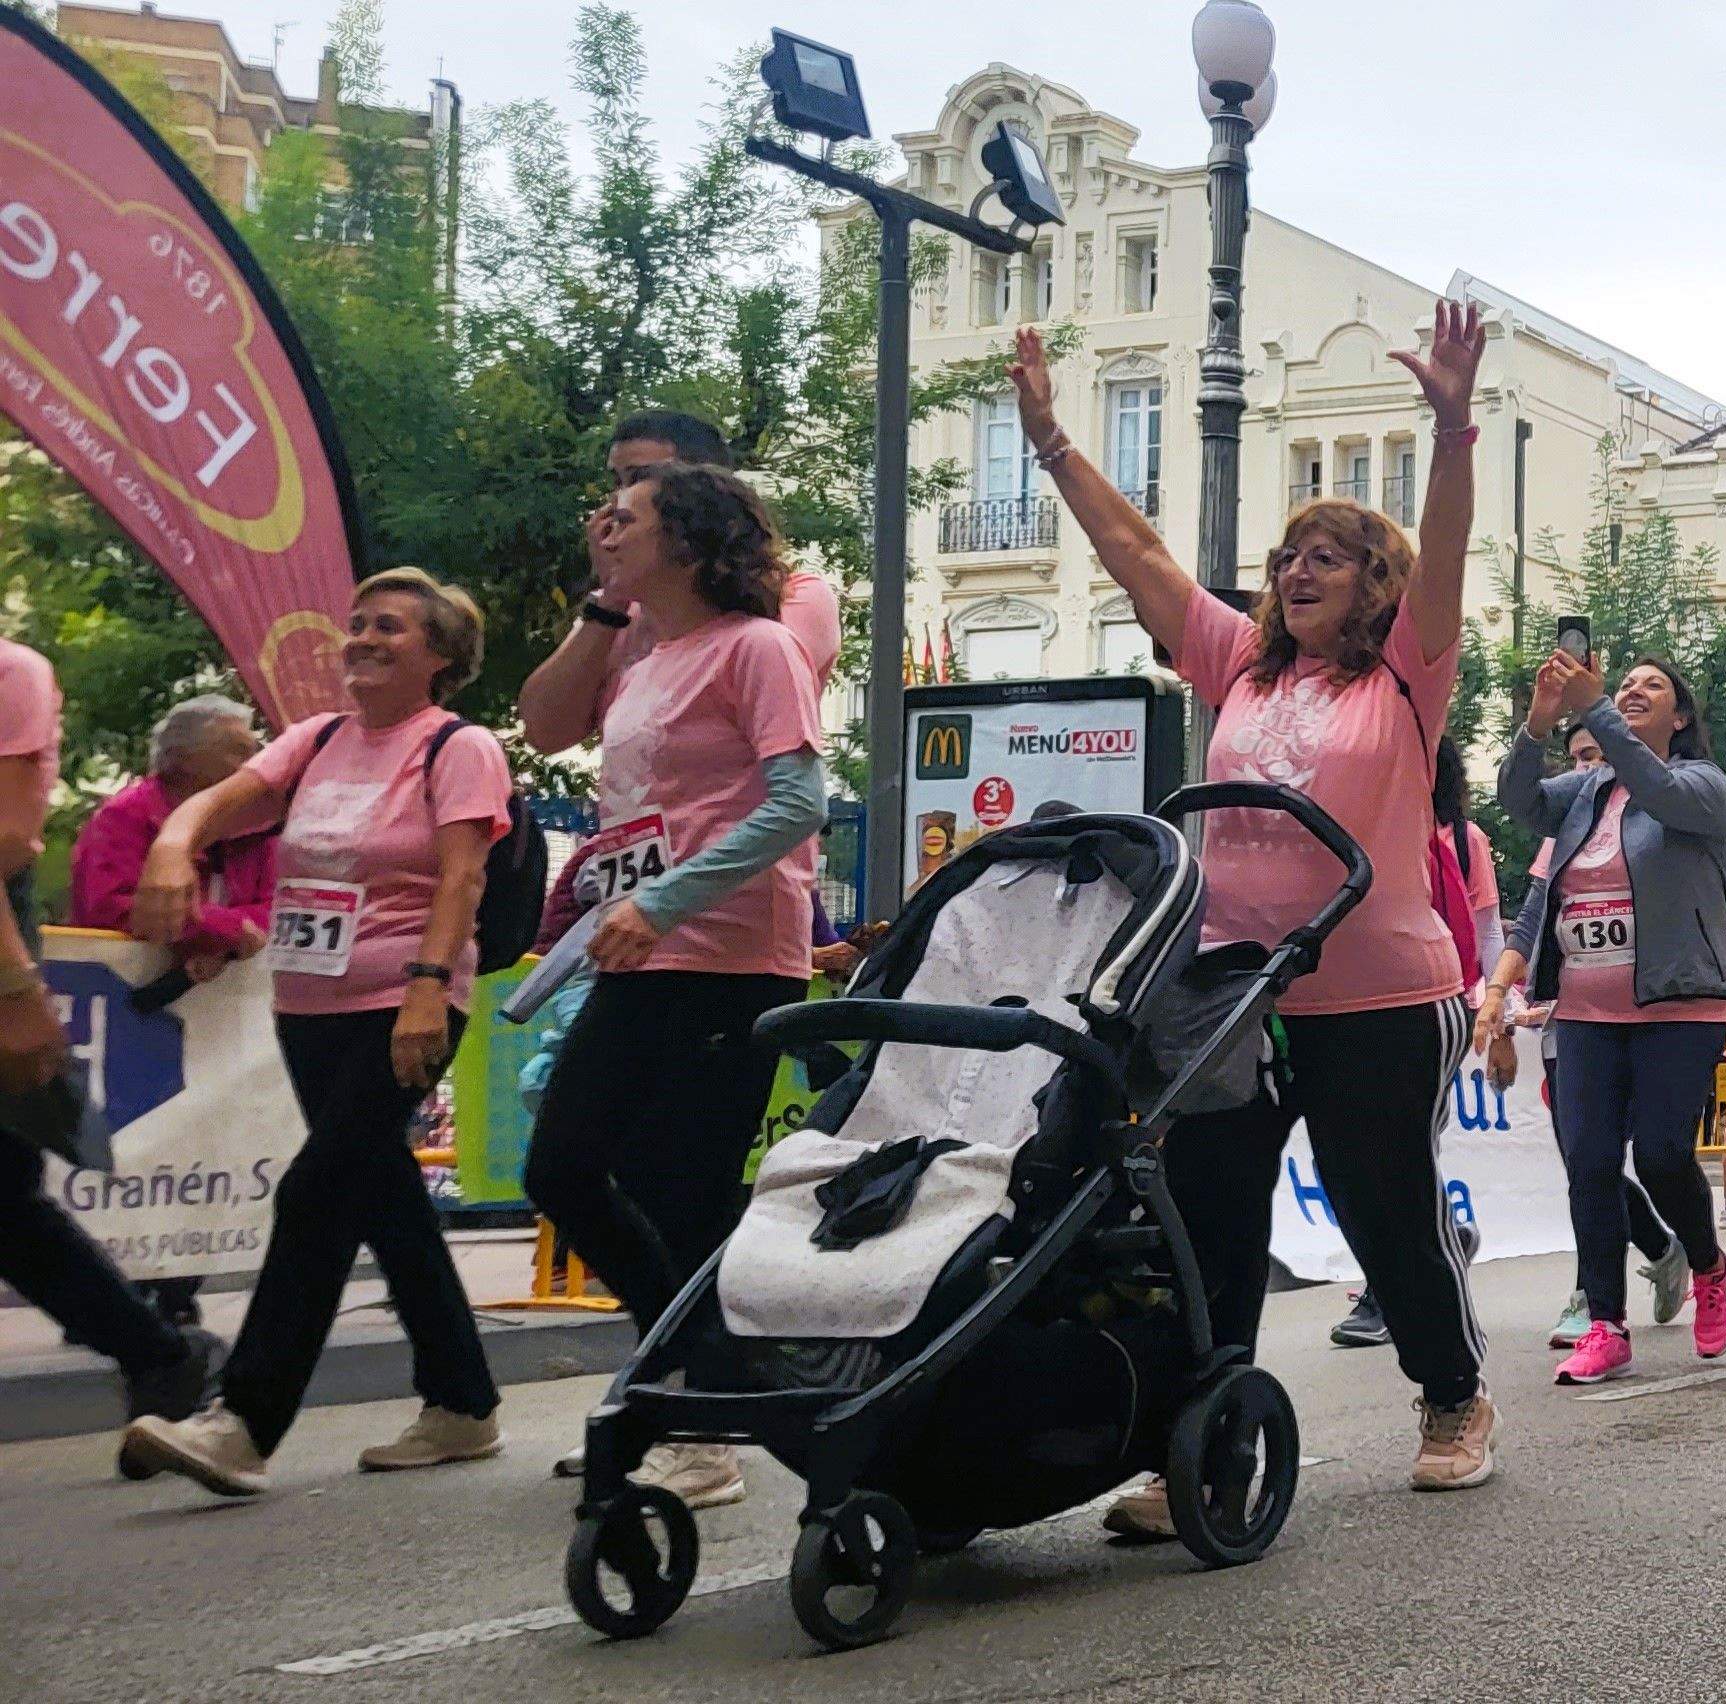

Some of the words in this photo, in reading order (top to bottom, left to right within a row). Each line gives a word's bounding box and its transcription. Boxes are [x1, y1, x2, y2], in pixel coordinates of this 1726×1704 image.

[1008, 727, 1071, 756] MENÚ
[1571, 918, 1628, 950] 130
[63, 1160, 241, 1211] Grañén,
